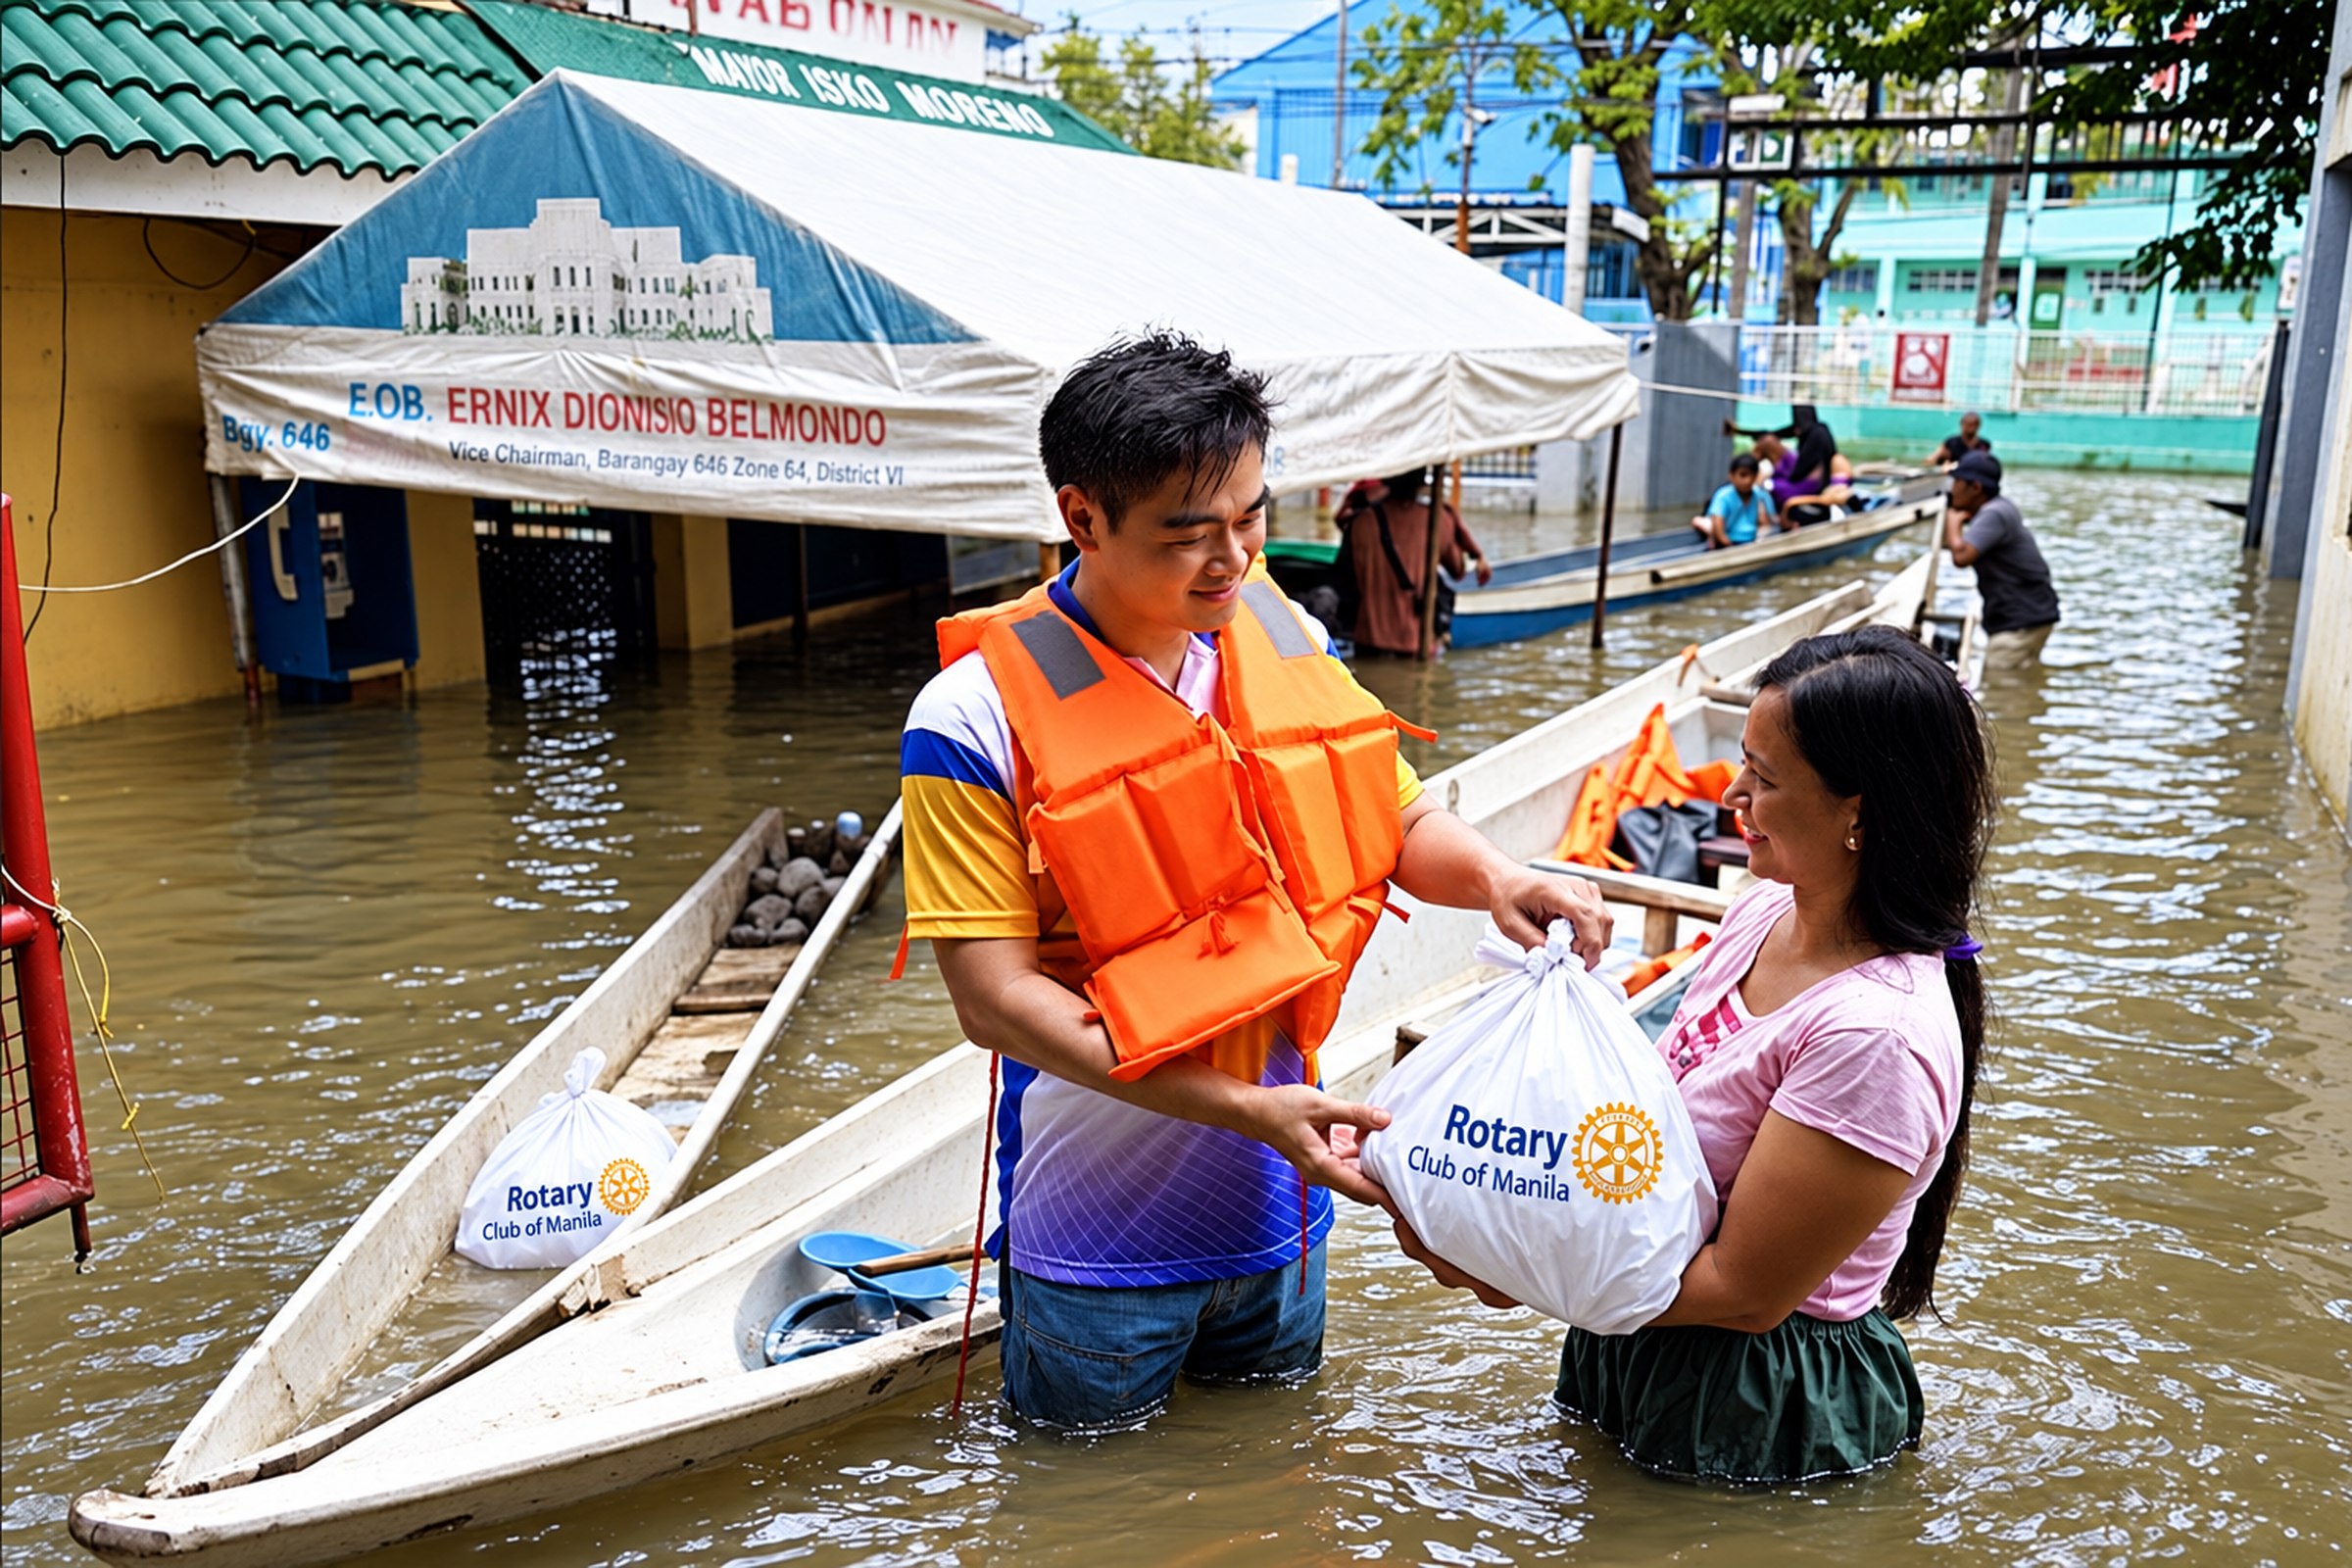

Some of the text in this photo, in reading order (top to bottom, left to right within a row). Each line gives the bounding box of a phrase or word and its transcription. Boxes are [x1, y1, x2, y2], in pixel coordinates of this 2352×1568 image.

[690, 46, 1054, 138] MAYOR ISKO MORENO
[222, 416, 273, 453] Bgy.
[282, 421, 330, 452] 646
[447, 387, 552, 428] ERNIX
[564, 392, 696, 435] DIONISIO
[707, 398, 886, 446] BELMONDO
[449, 442, 490, 463] Vice
[495, 444, 591, 470] Chairman,
[598, 449, 688, 478] Barangay
[694, 454, 727, 476] 646
[733, 457, 779, 478] Zone
[785, 461, 810, 483] 64,
[816, 462, 880, 484] District
[886, 466, 905, 485] VI
[1444, 1104, 1567, 1170] Rotary
[507, 1182, 593, 1211] Rotary
[1408, 1146, 1456, 1181] Club
[1462, 1162, 1489, 1188] of
[1493, 1167, 1570, 1202] Manila
[482, 1211, 603, 1241] Club of Manila
